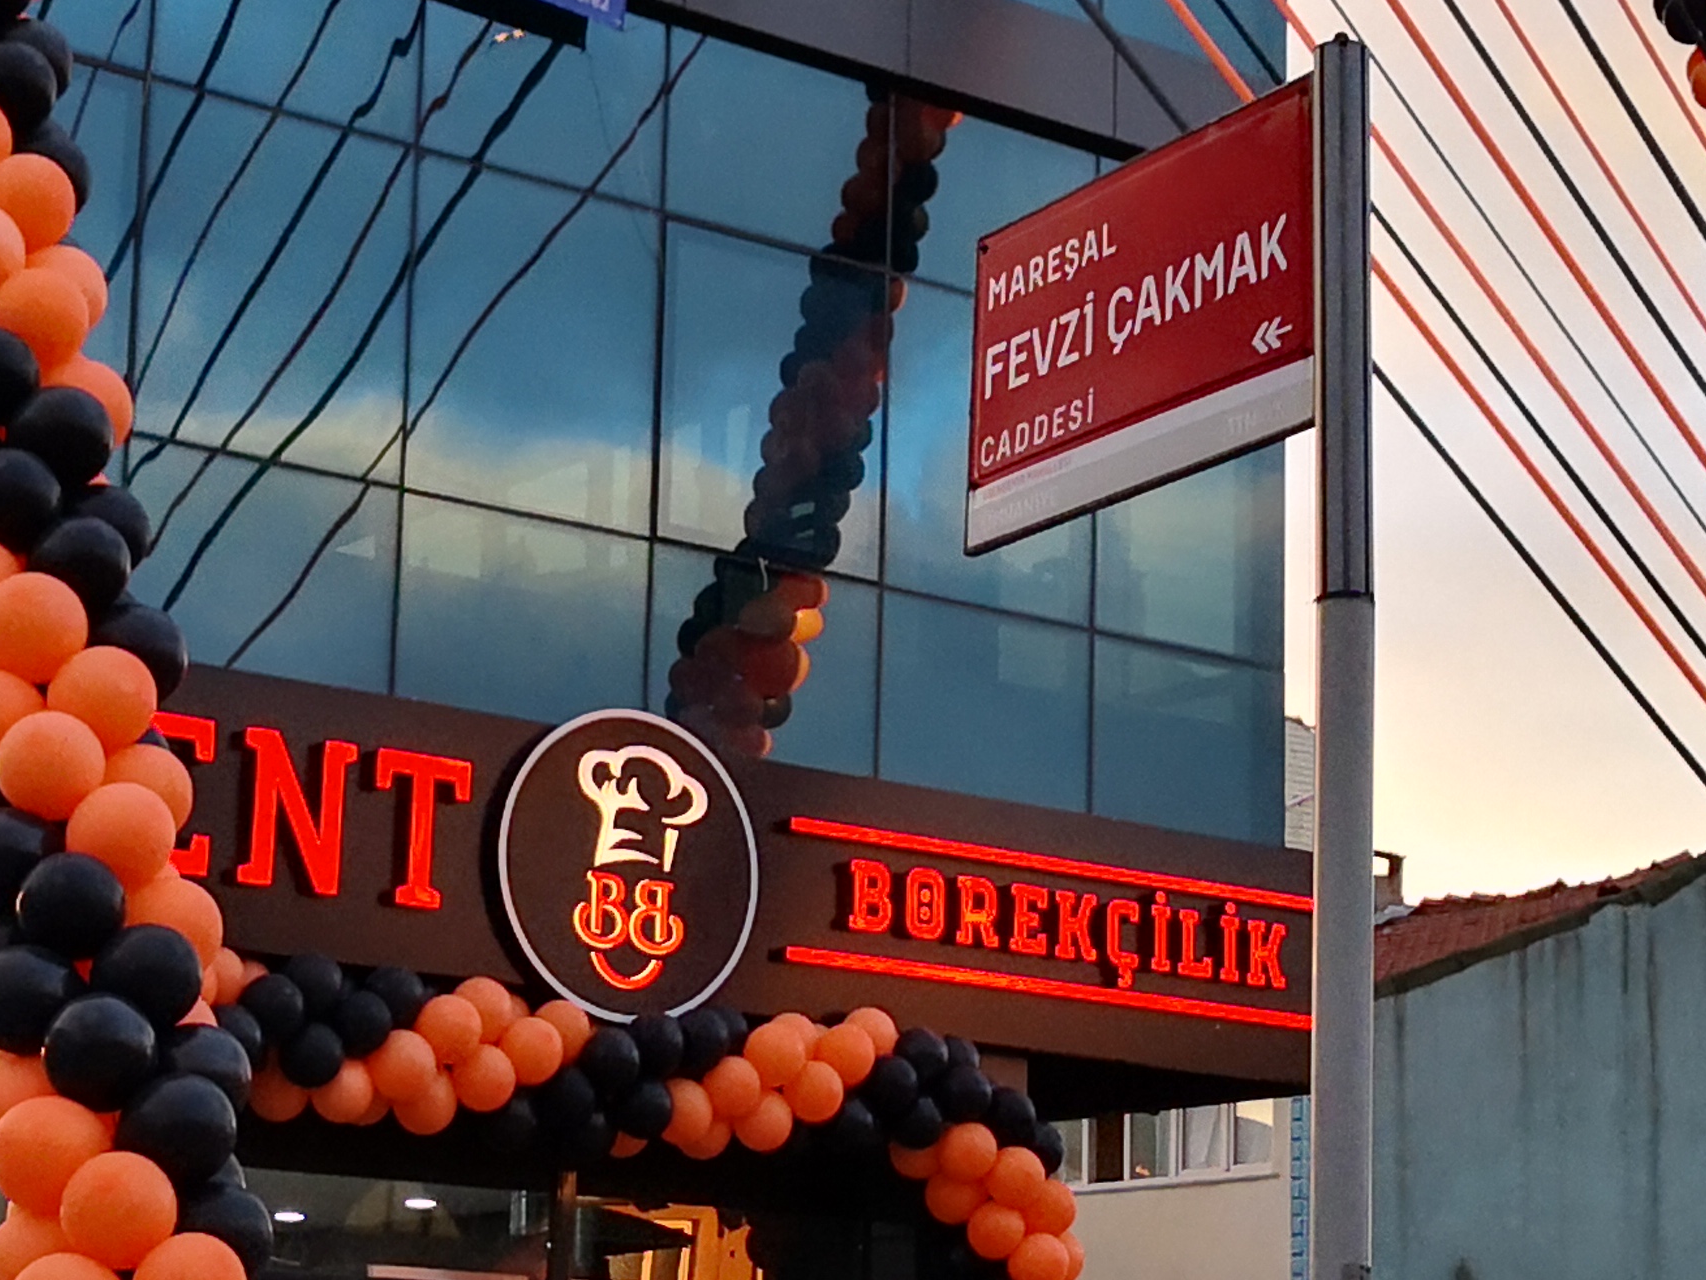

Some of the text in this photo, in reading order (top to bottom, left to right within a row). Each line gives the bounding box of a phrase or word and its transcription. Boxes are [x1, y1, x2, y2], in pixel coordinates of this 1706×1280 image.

[983, 212, 1289, 401] FEVZİ ÇAKMAK
[987, 222, 1118, 312] MAREŞAL
[980, 386, 1095, 468] CADDESİ
[848, 857, 1287, 989] BÖREKÇİLİK
